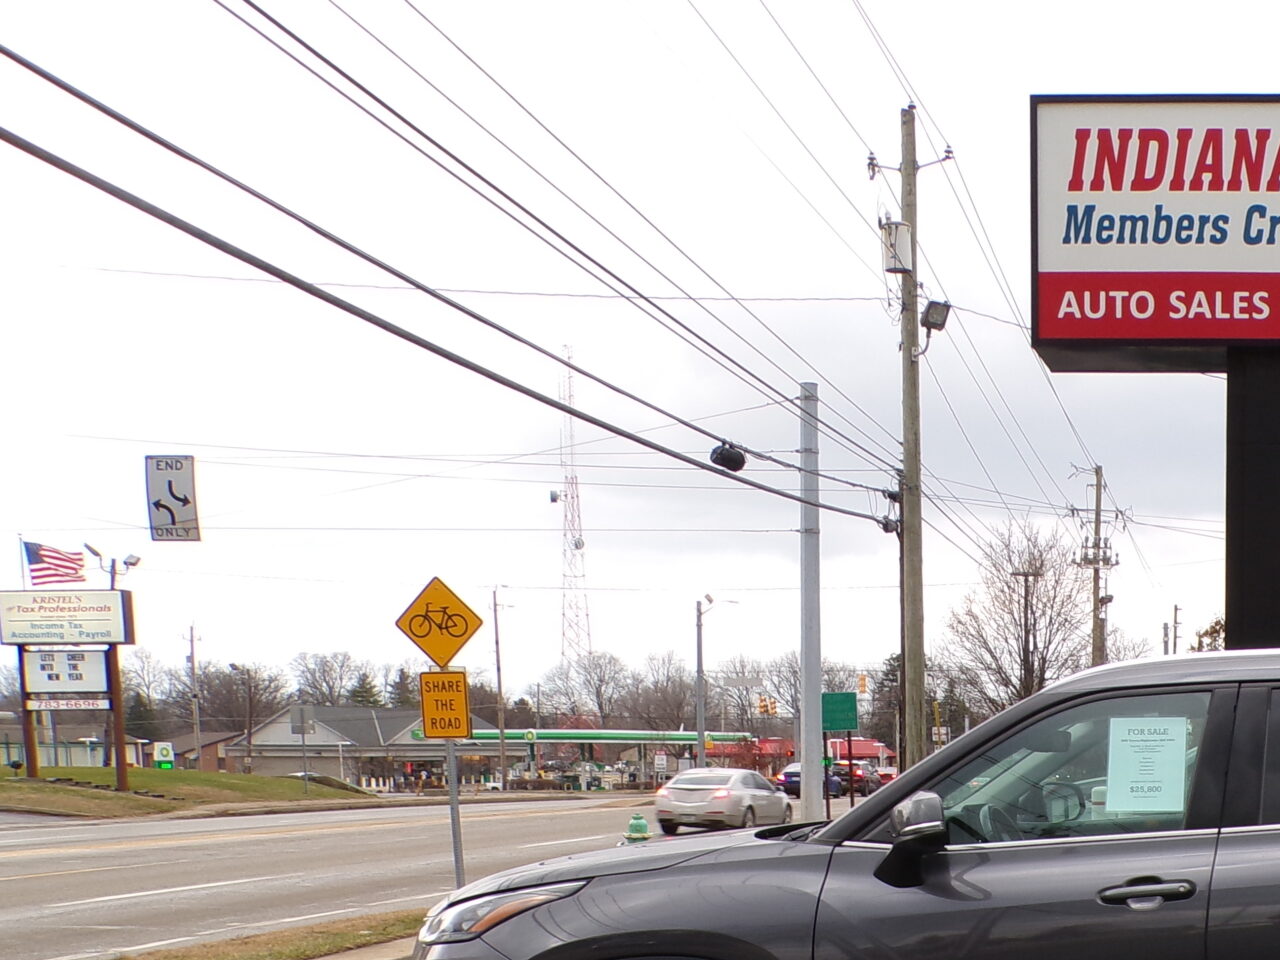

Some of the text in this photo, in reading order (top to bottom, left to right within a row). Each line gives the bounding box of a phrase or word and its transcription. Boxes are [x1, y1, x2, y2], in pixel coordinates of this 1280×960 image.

[1062, 204, 1230, 244] Members
[1057, 290, 1155, 319] AUTO
[1169, 290, 1270, 320] SALES
[156, 460, 184, 471] END
[156, 528, 191, 538] ONLY
[16, 604, 112, 613] Tax Professionals
[30, 622, 64, 630] Income
[10, 631, 65, 640] Accounting
[78, 630, 112, 640] Payroll
[424, 680, 463, 693] SHARE
[37, 700, 100, 709] 783-6696
[433, 699, 456, 712] THE
[431, 717, 461, 730] ROAD
[1127, 728, 1169, 736] FOR SALE
